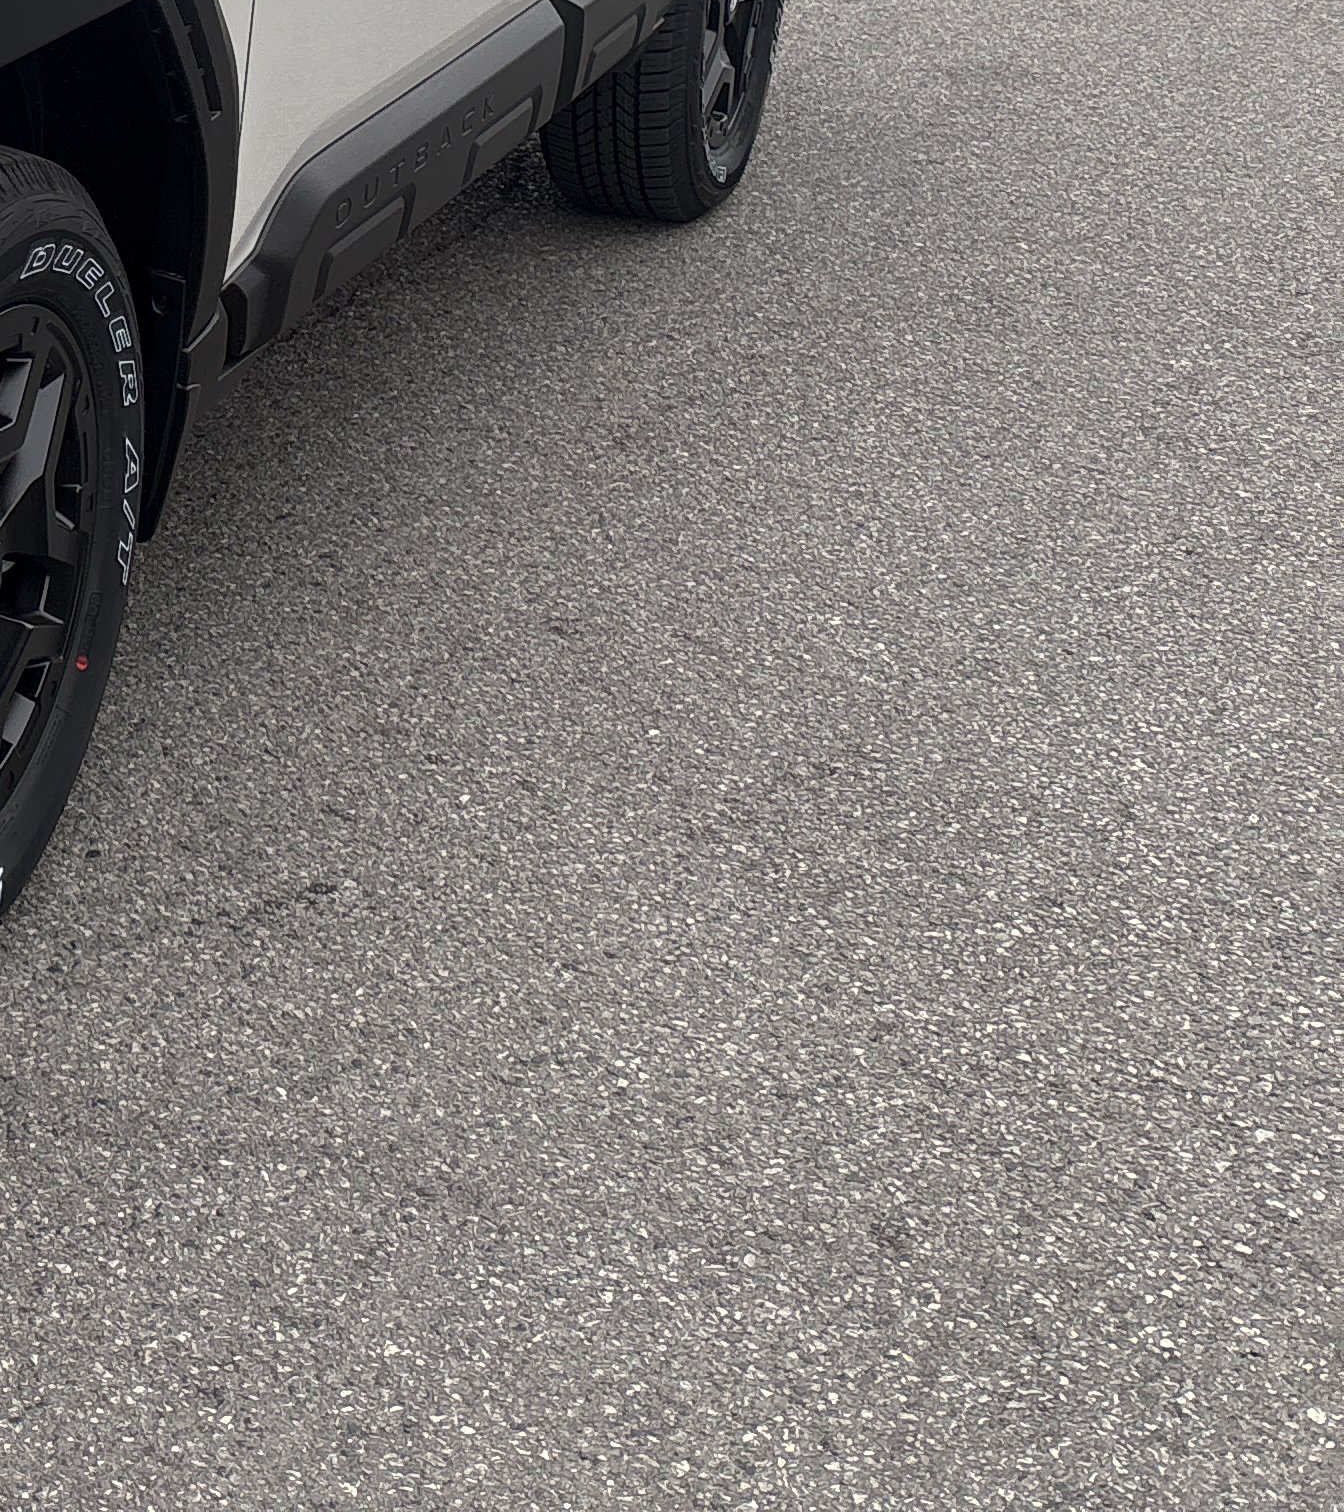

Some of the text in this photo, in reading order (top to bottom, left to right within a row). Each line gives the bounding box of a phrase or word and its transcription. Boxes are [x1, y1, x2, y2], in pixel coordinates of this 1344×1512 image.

[335, 92, 495, 230] OUTBACK
[20, 243, 140, 586] DUELER A/T
